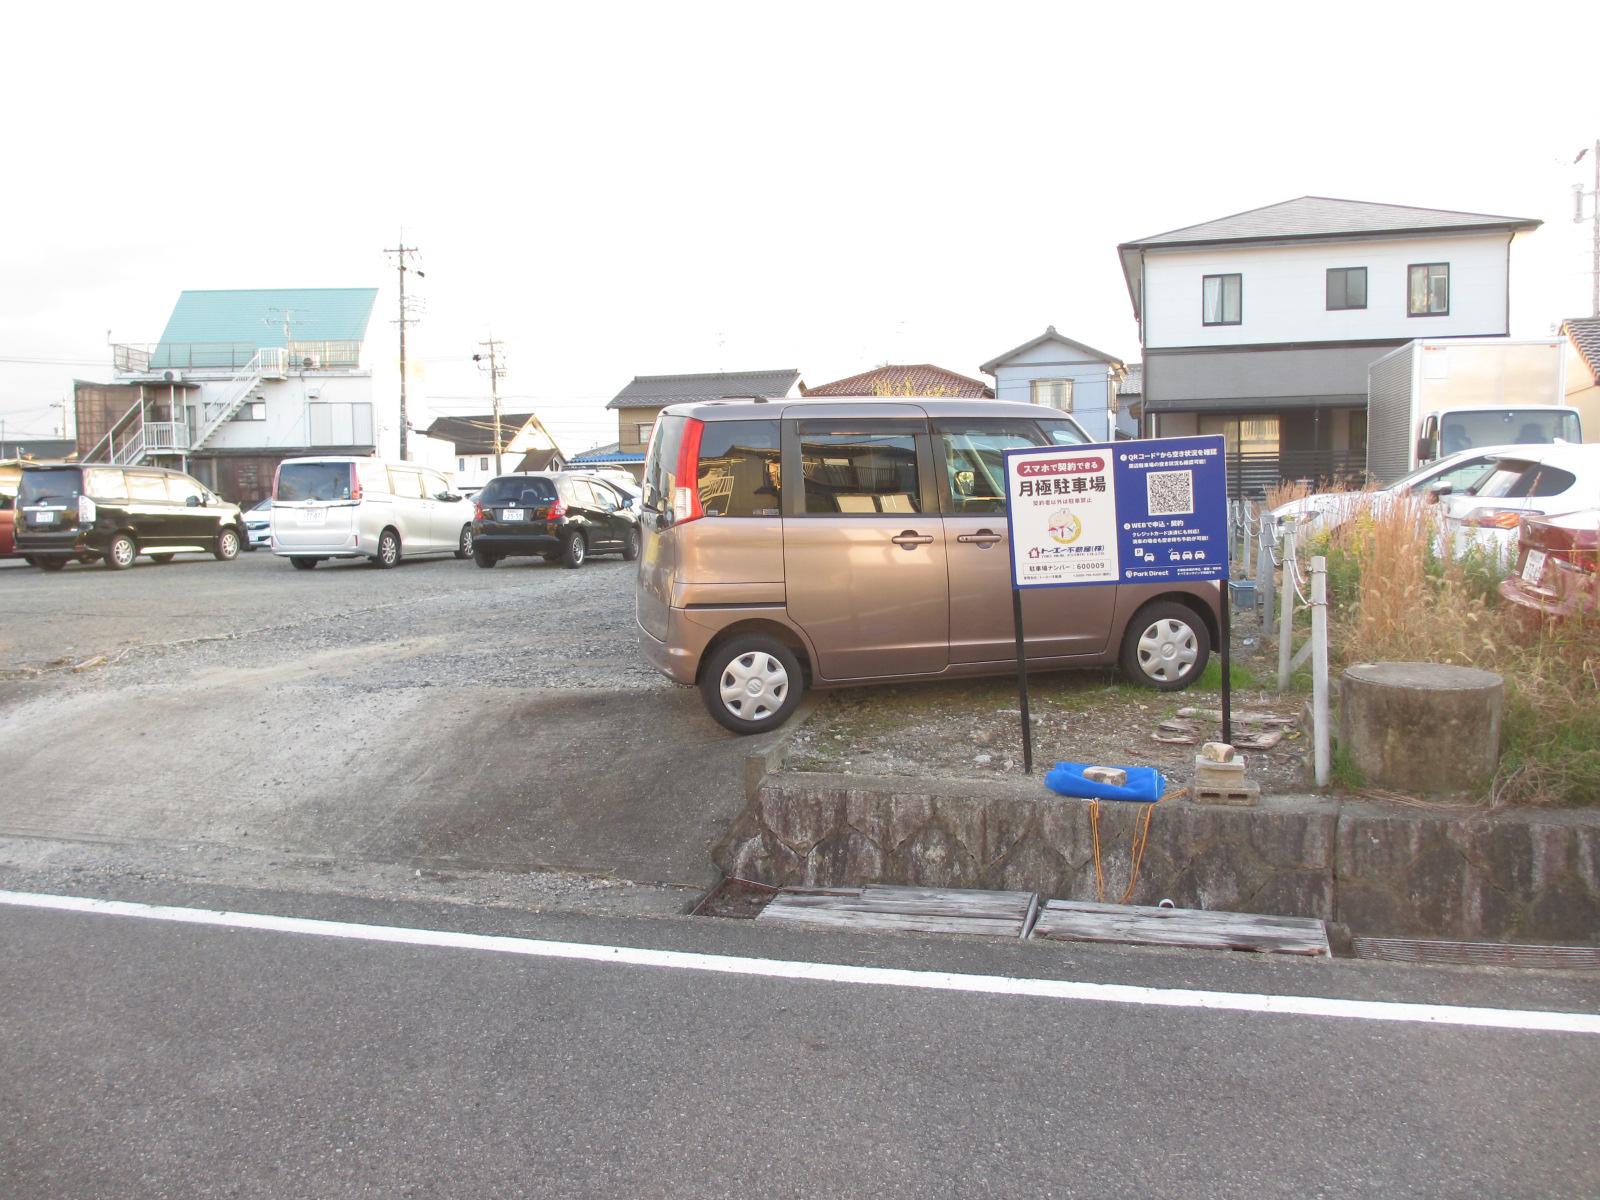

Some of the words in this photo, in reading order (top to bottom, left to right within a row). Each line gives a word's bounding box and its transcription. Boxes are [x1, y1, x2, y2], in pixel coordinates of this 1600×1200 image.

[1023, 461, 1098, 474] スマホで契約できる
[1019, 475, 1106, 497] 月極駐車場
[1032, 497, 1093, 507] 契約者以外は駐車禁止
[1131, 520, 1184, 530] WEBで申込・契約
[1149, 569, 1169, 577] Direct
